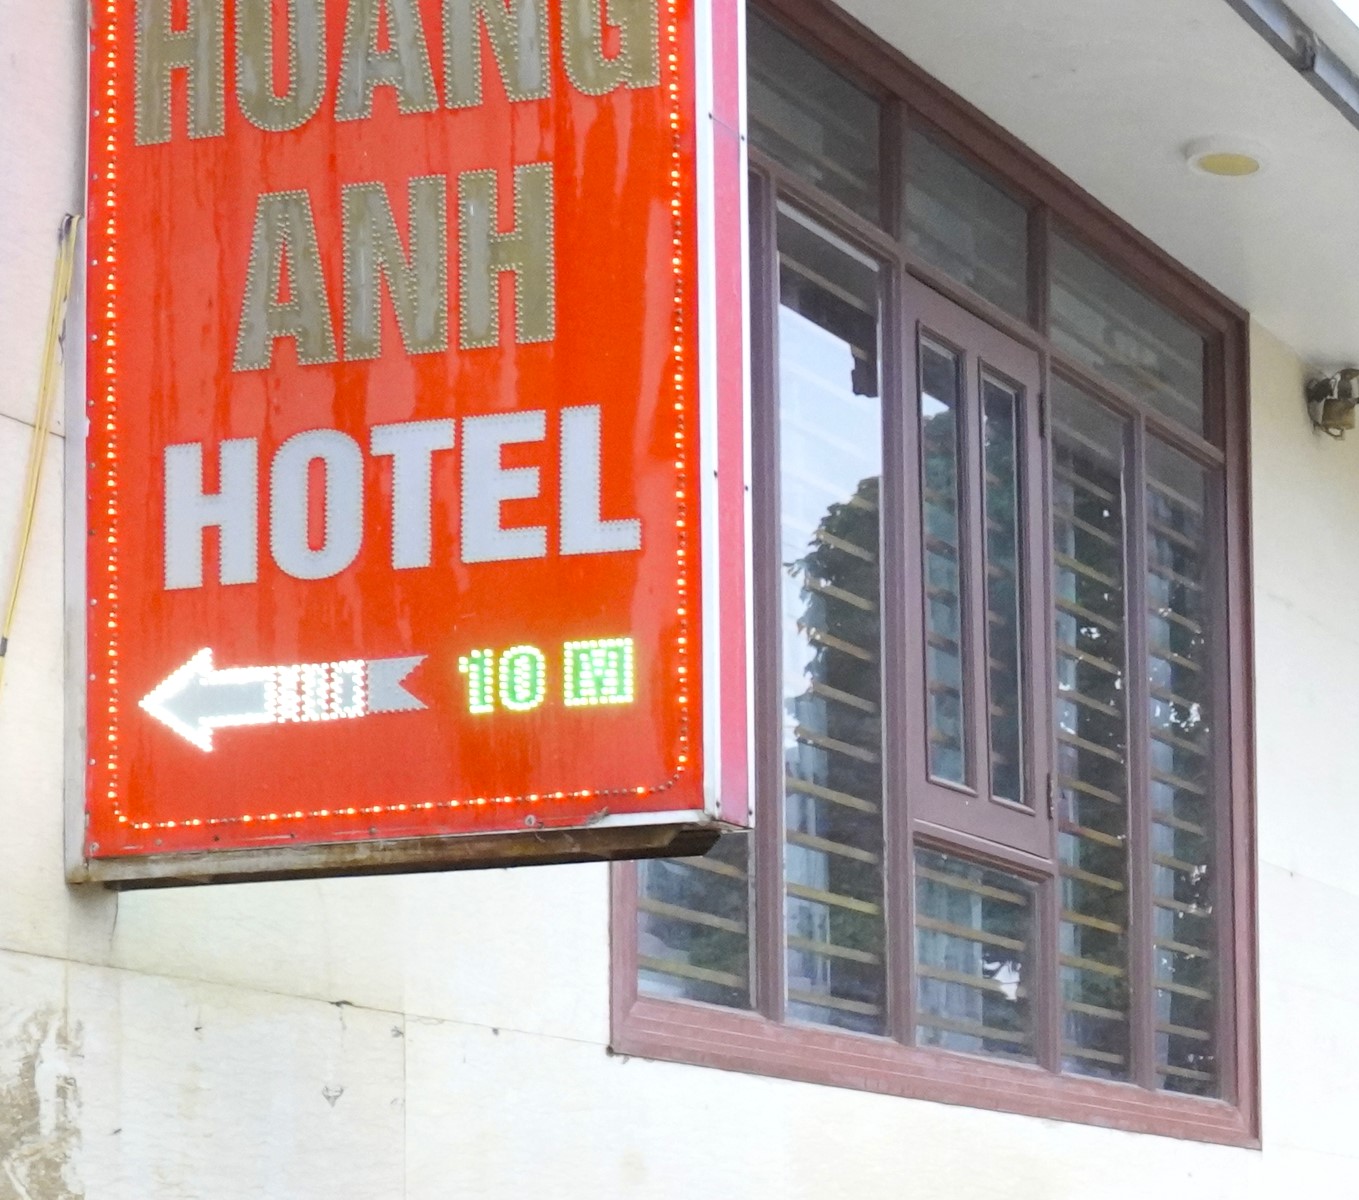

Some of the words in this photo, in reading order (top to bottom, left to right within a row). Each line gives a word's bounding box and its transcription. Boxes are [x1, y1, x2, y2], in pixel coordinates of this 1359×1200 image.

[231, 162, 556, 373] ANH
[163, 404, 641, 591] HOTEL
[459, 645, 546, 714] 10
[563, 637, 635, 706] M
